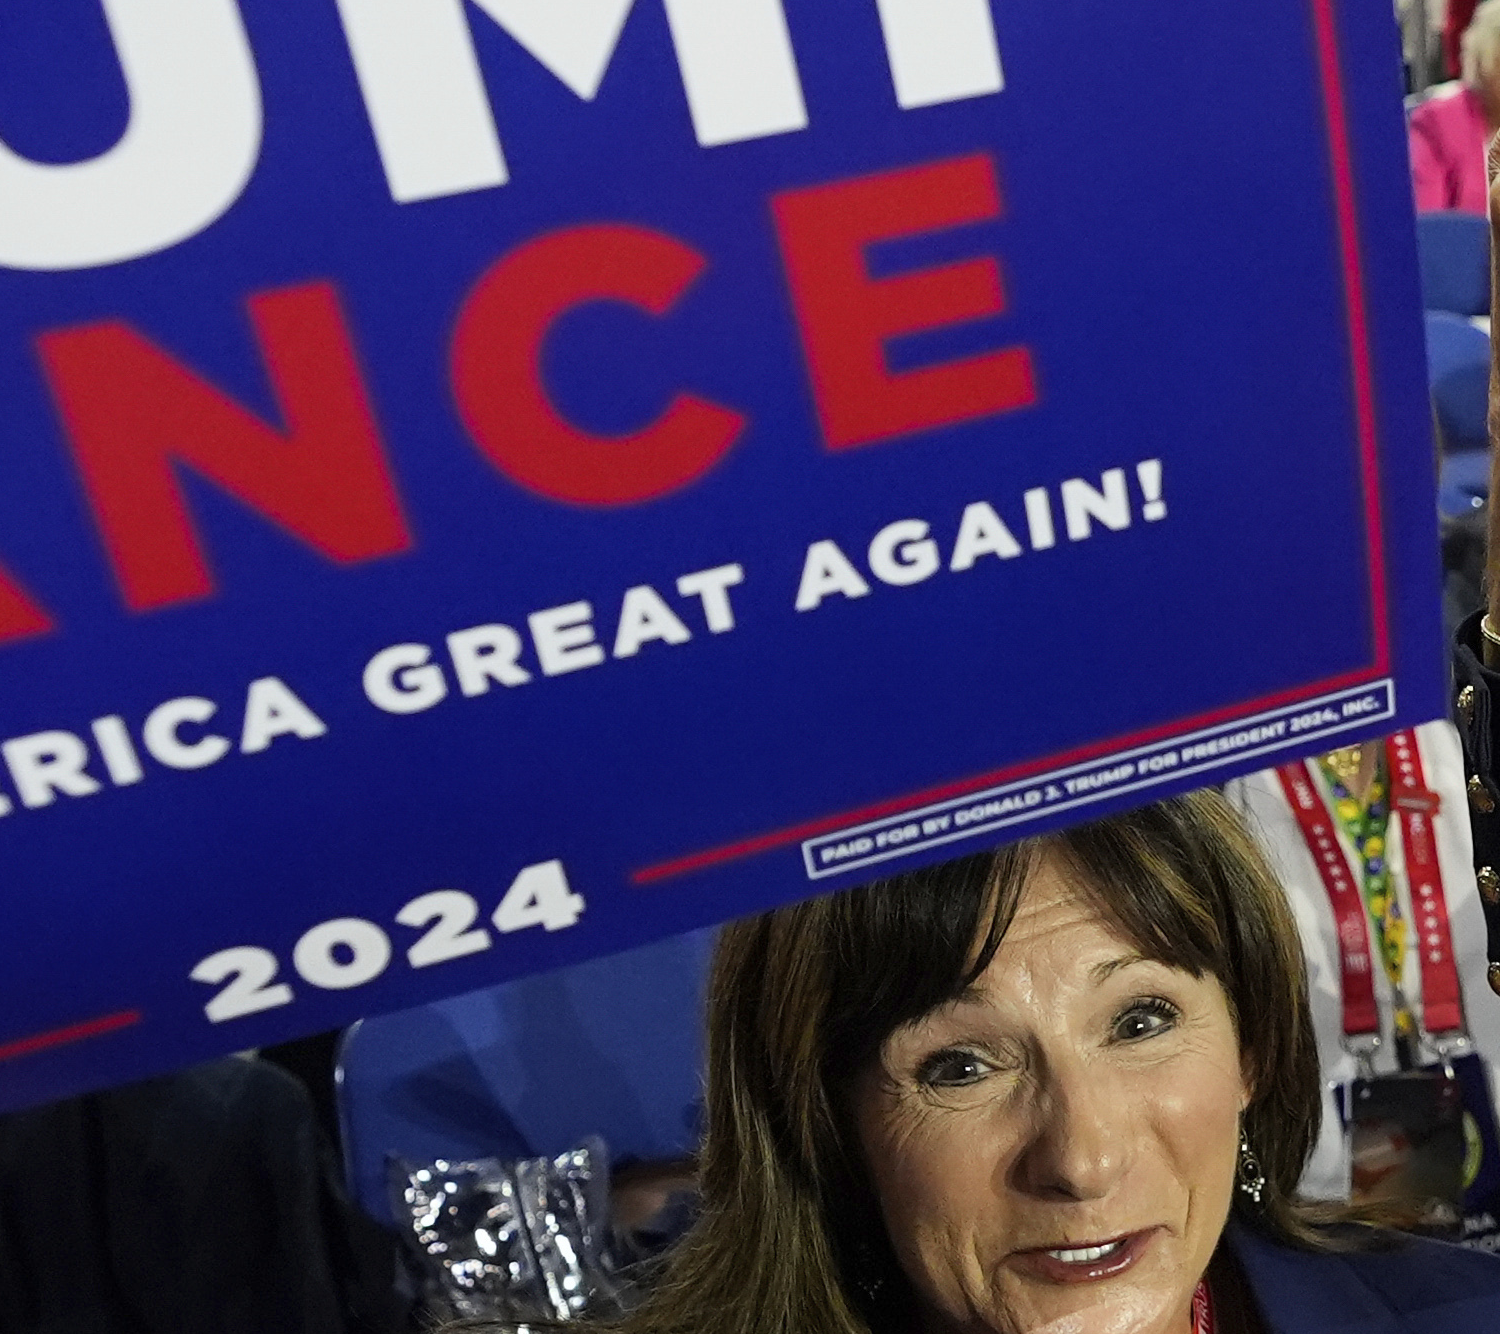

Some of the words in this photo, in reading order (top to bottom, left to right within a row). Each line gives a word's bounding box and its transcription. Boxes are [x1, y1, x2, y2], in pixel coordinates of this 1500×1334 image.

[362, 564, 743, 714] GREAT
[795, 459, 1167, 611] AGAIN!
[820, 835, 875, 864] PAID
[875, 824, 920, 849] FOR
[921, 813, 950, 837] BY
[953, 789, 1042, 827] DONALD
[1065, 763, 1135, 795] TRUMP
[1137, 751, 1179, 775] FOR
[1181, 720, 1288, 763] PRESIDENT
[1289, 708, 1340, 733] 2024,
[1342, 695, 1382, 717] INC.
[191, 859, 584, 1023] 2024
